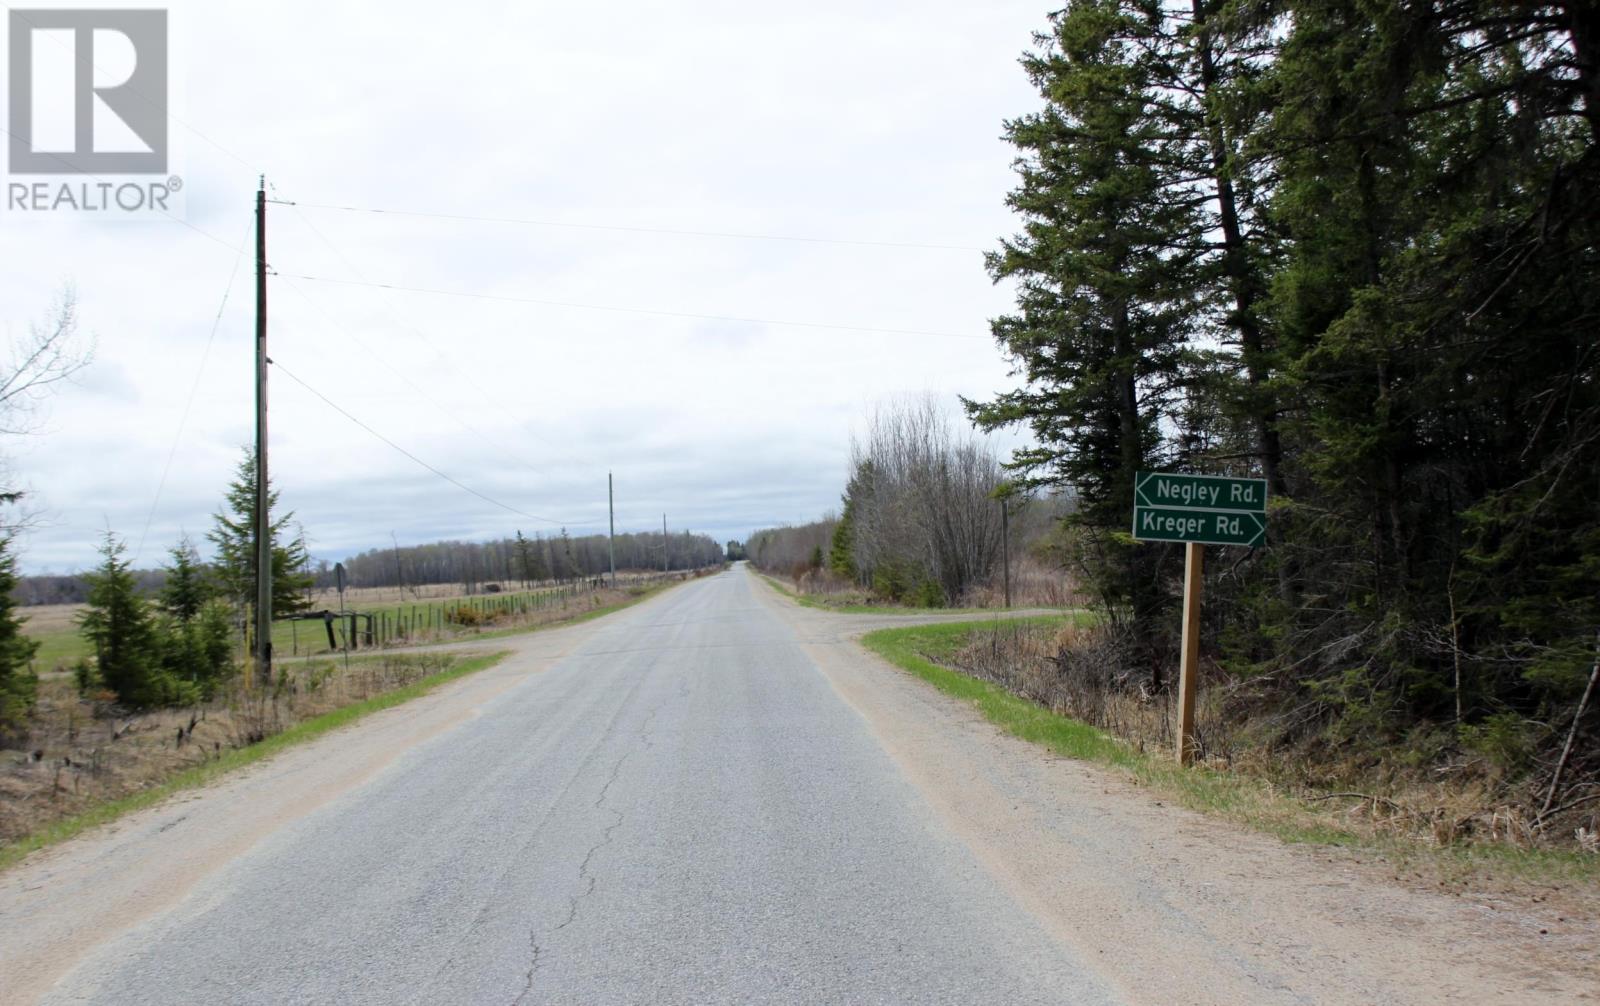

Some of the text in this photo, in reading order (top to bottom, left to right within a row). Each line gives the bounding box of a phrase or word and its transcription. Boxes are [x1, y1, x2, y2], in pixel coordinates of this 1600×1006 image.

[1157, 479, 1258, 505] Negley Rd.
[1142, 511, 1244, 537] Kreger Rd.
